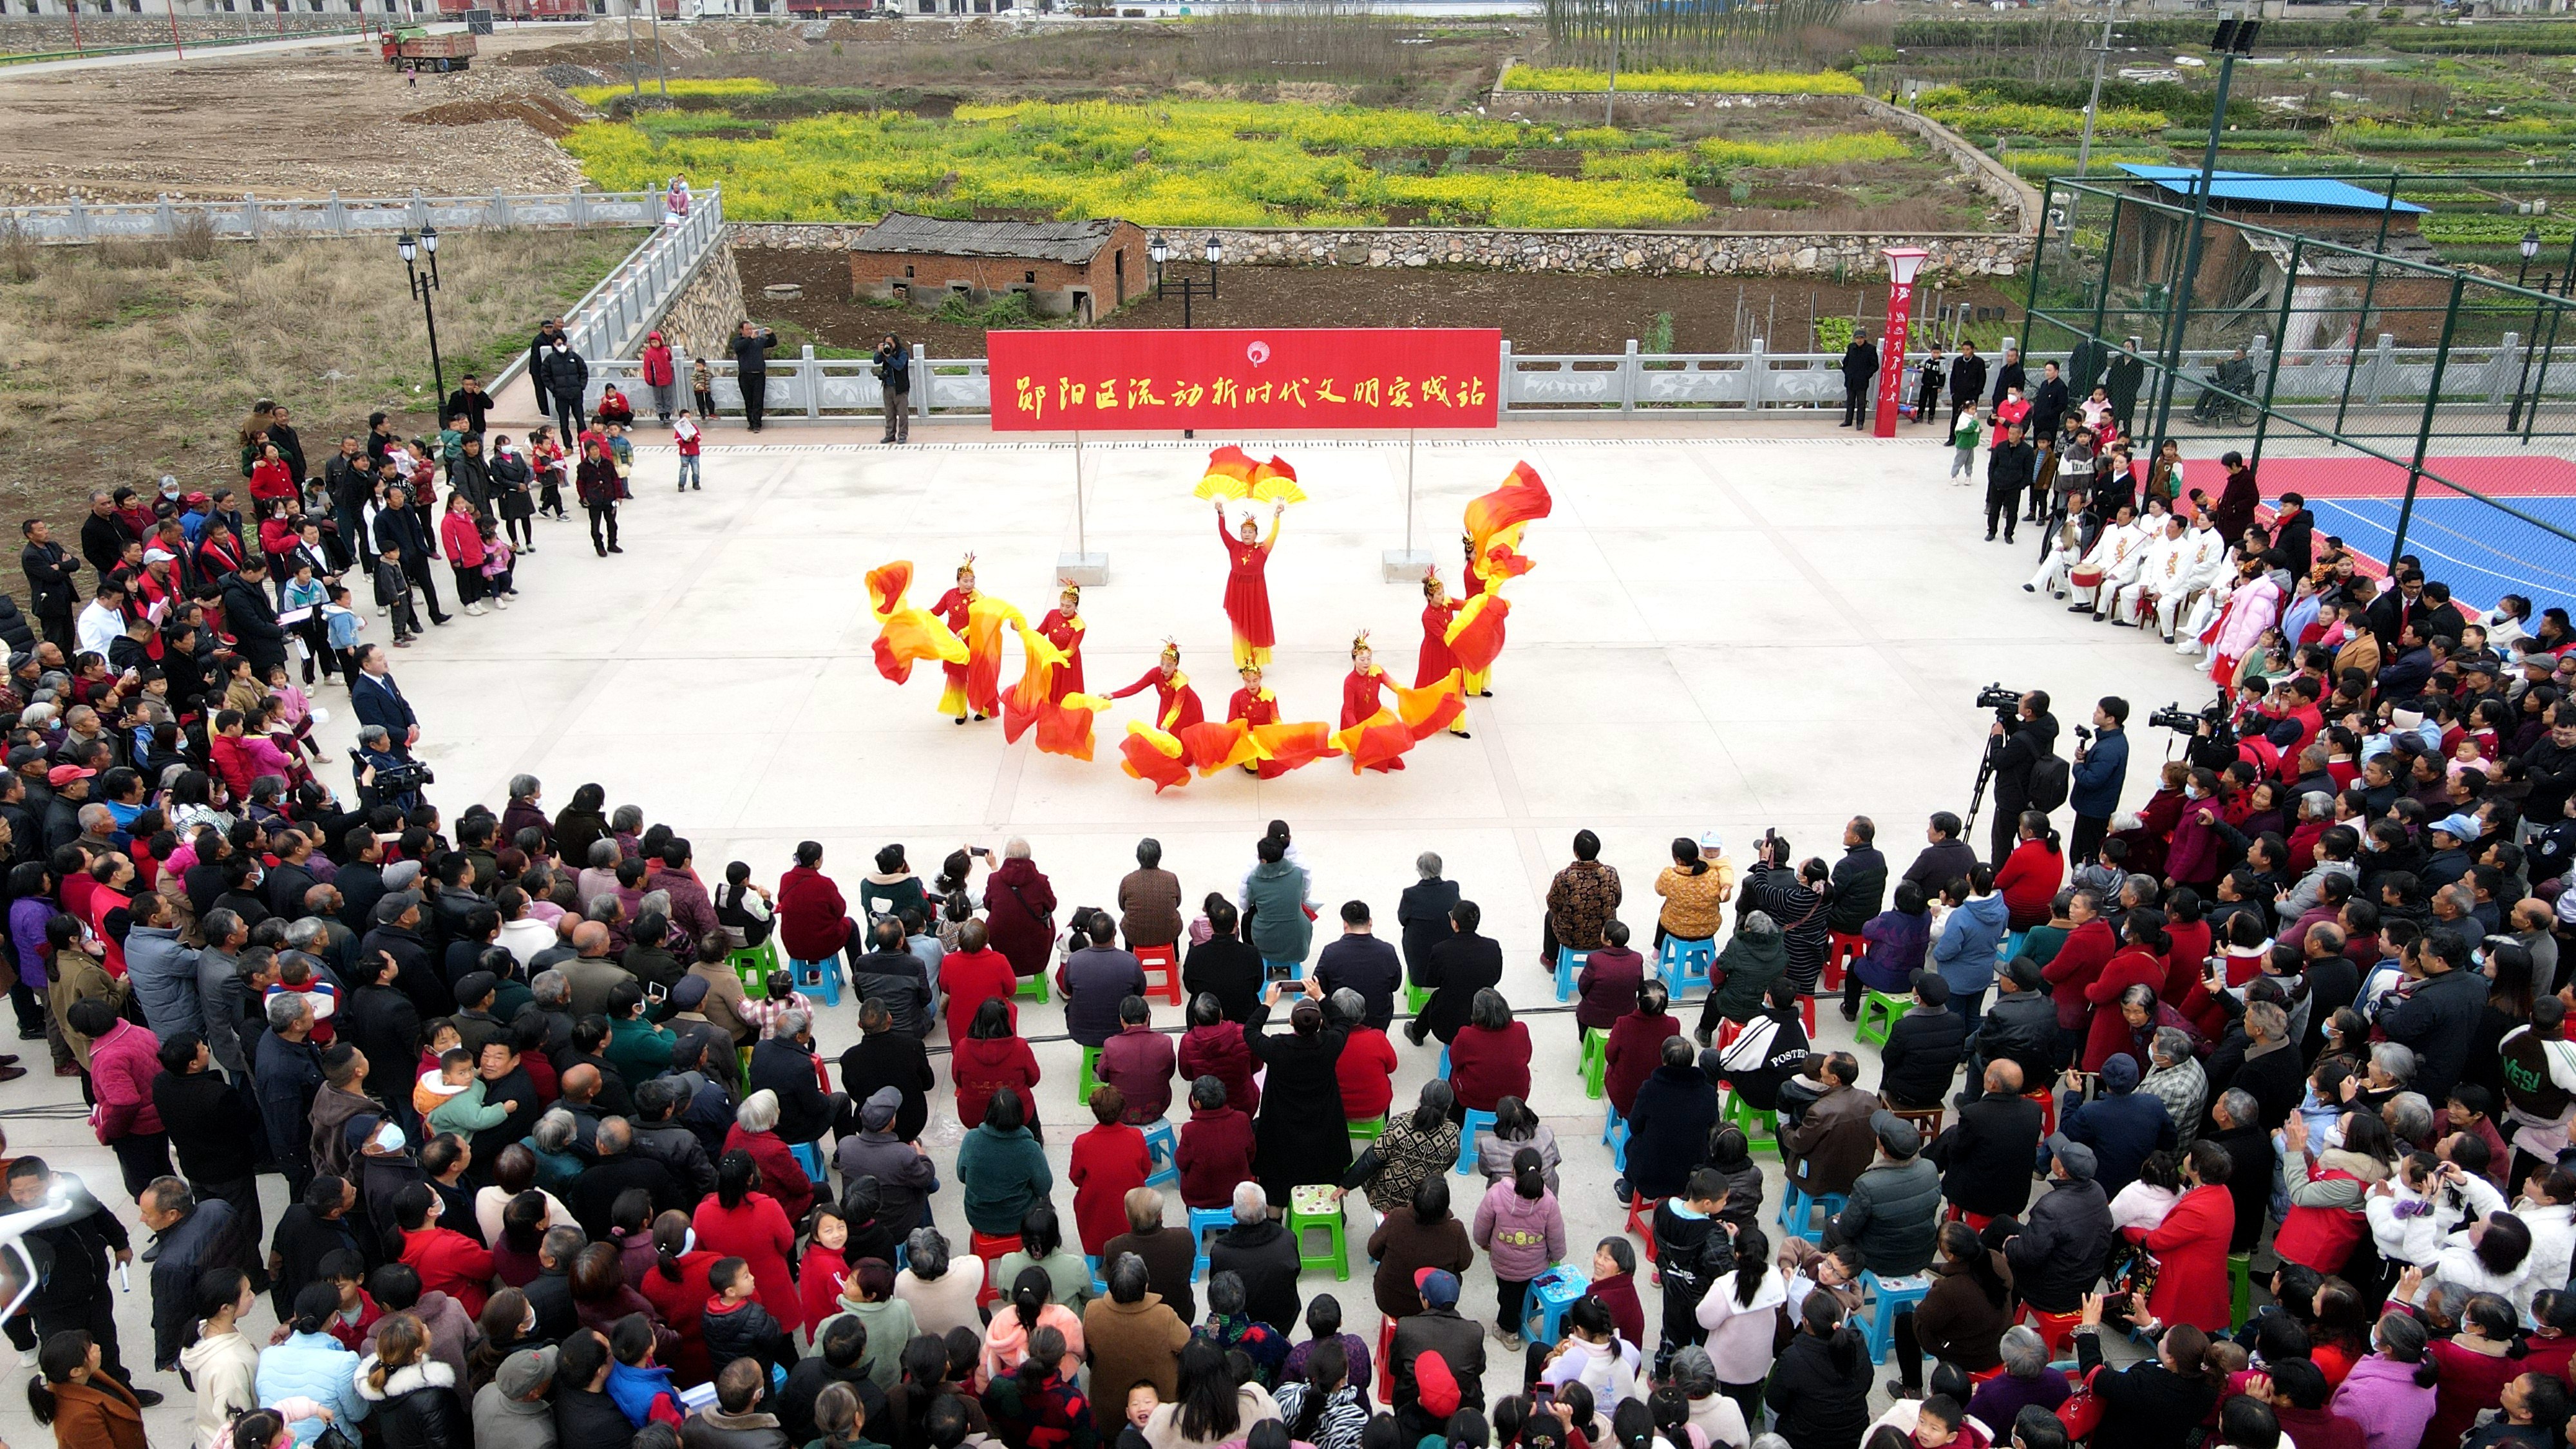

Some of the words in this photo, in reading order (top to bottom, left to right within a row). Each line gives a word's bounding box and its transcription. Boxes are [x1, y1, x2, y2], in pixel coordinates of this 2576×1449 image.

[1016, 375, 1486, 420] 郧阳区流动新时代文明实践站
[2503, 1056, 2541, 1093] YES!
